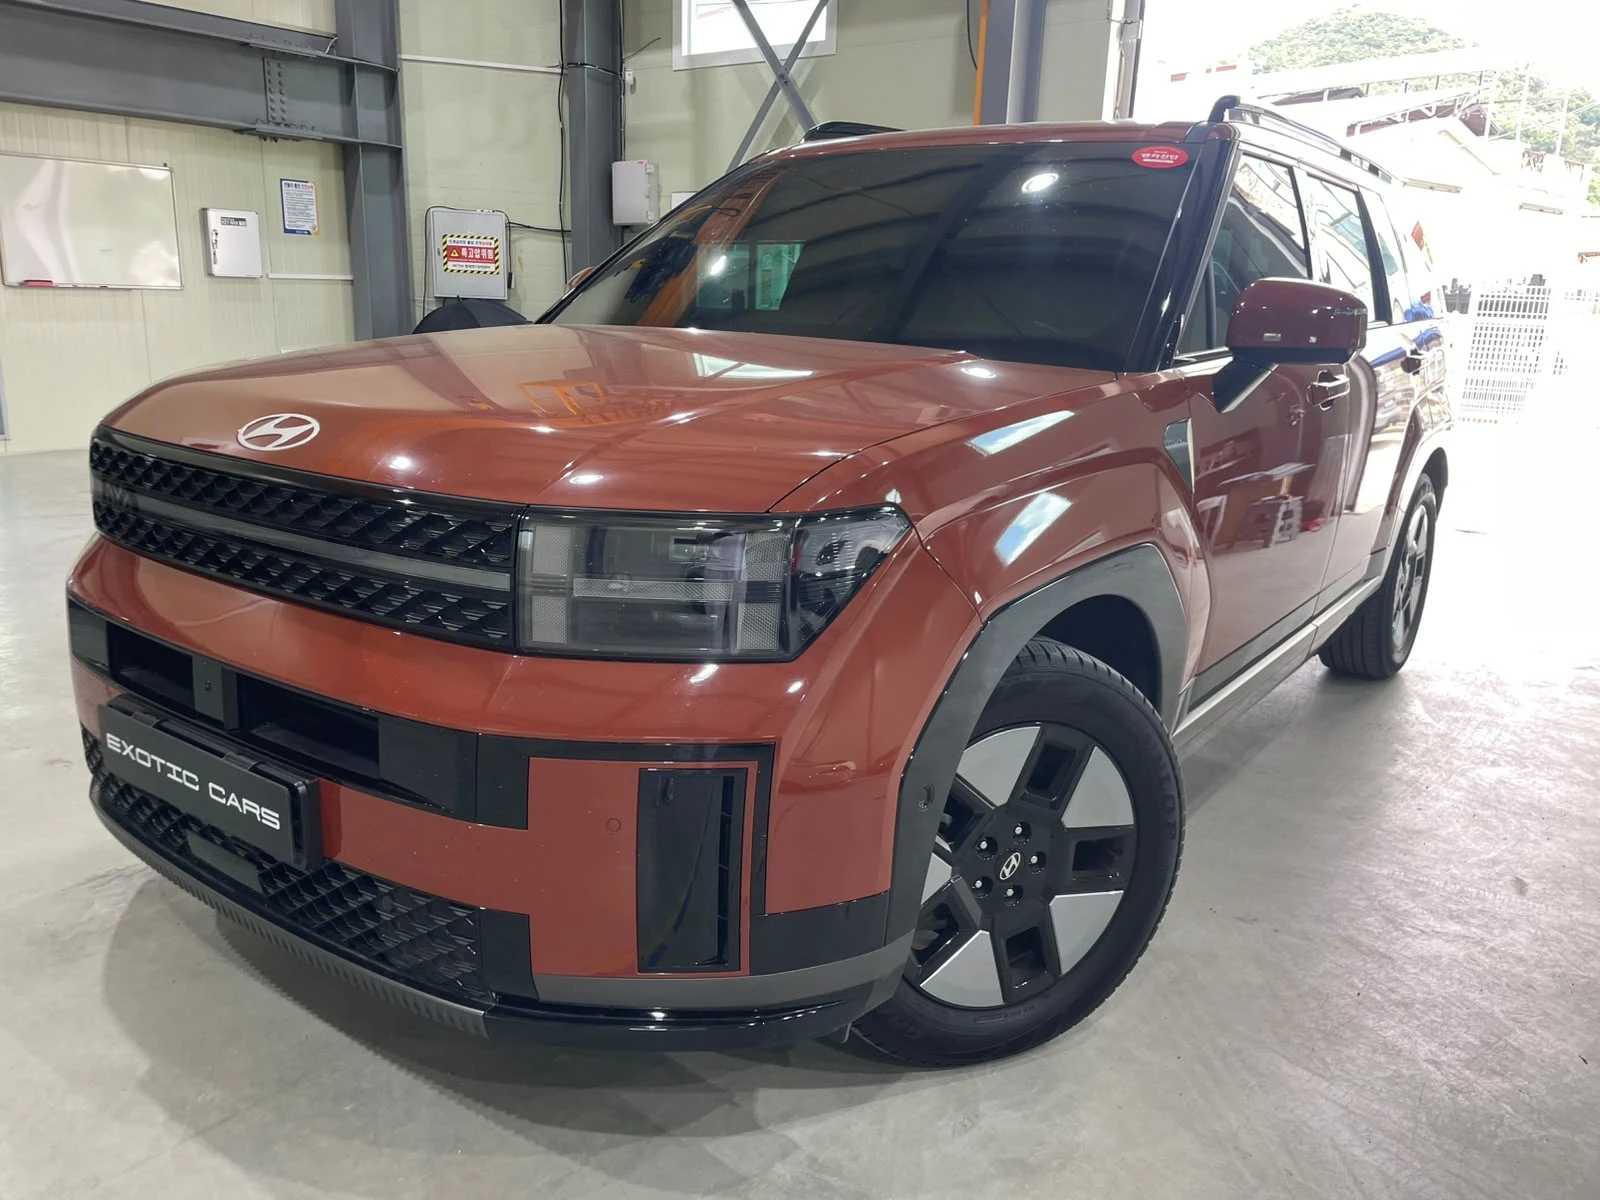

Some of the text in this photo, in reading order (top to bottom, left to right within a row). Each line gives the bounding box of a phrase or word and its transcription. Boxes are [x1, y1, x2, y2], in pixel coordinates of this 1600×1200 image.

[461, 247, 494, 260] 특고압위험
[106, 732, 280, 830] EXOTIC CARS
